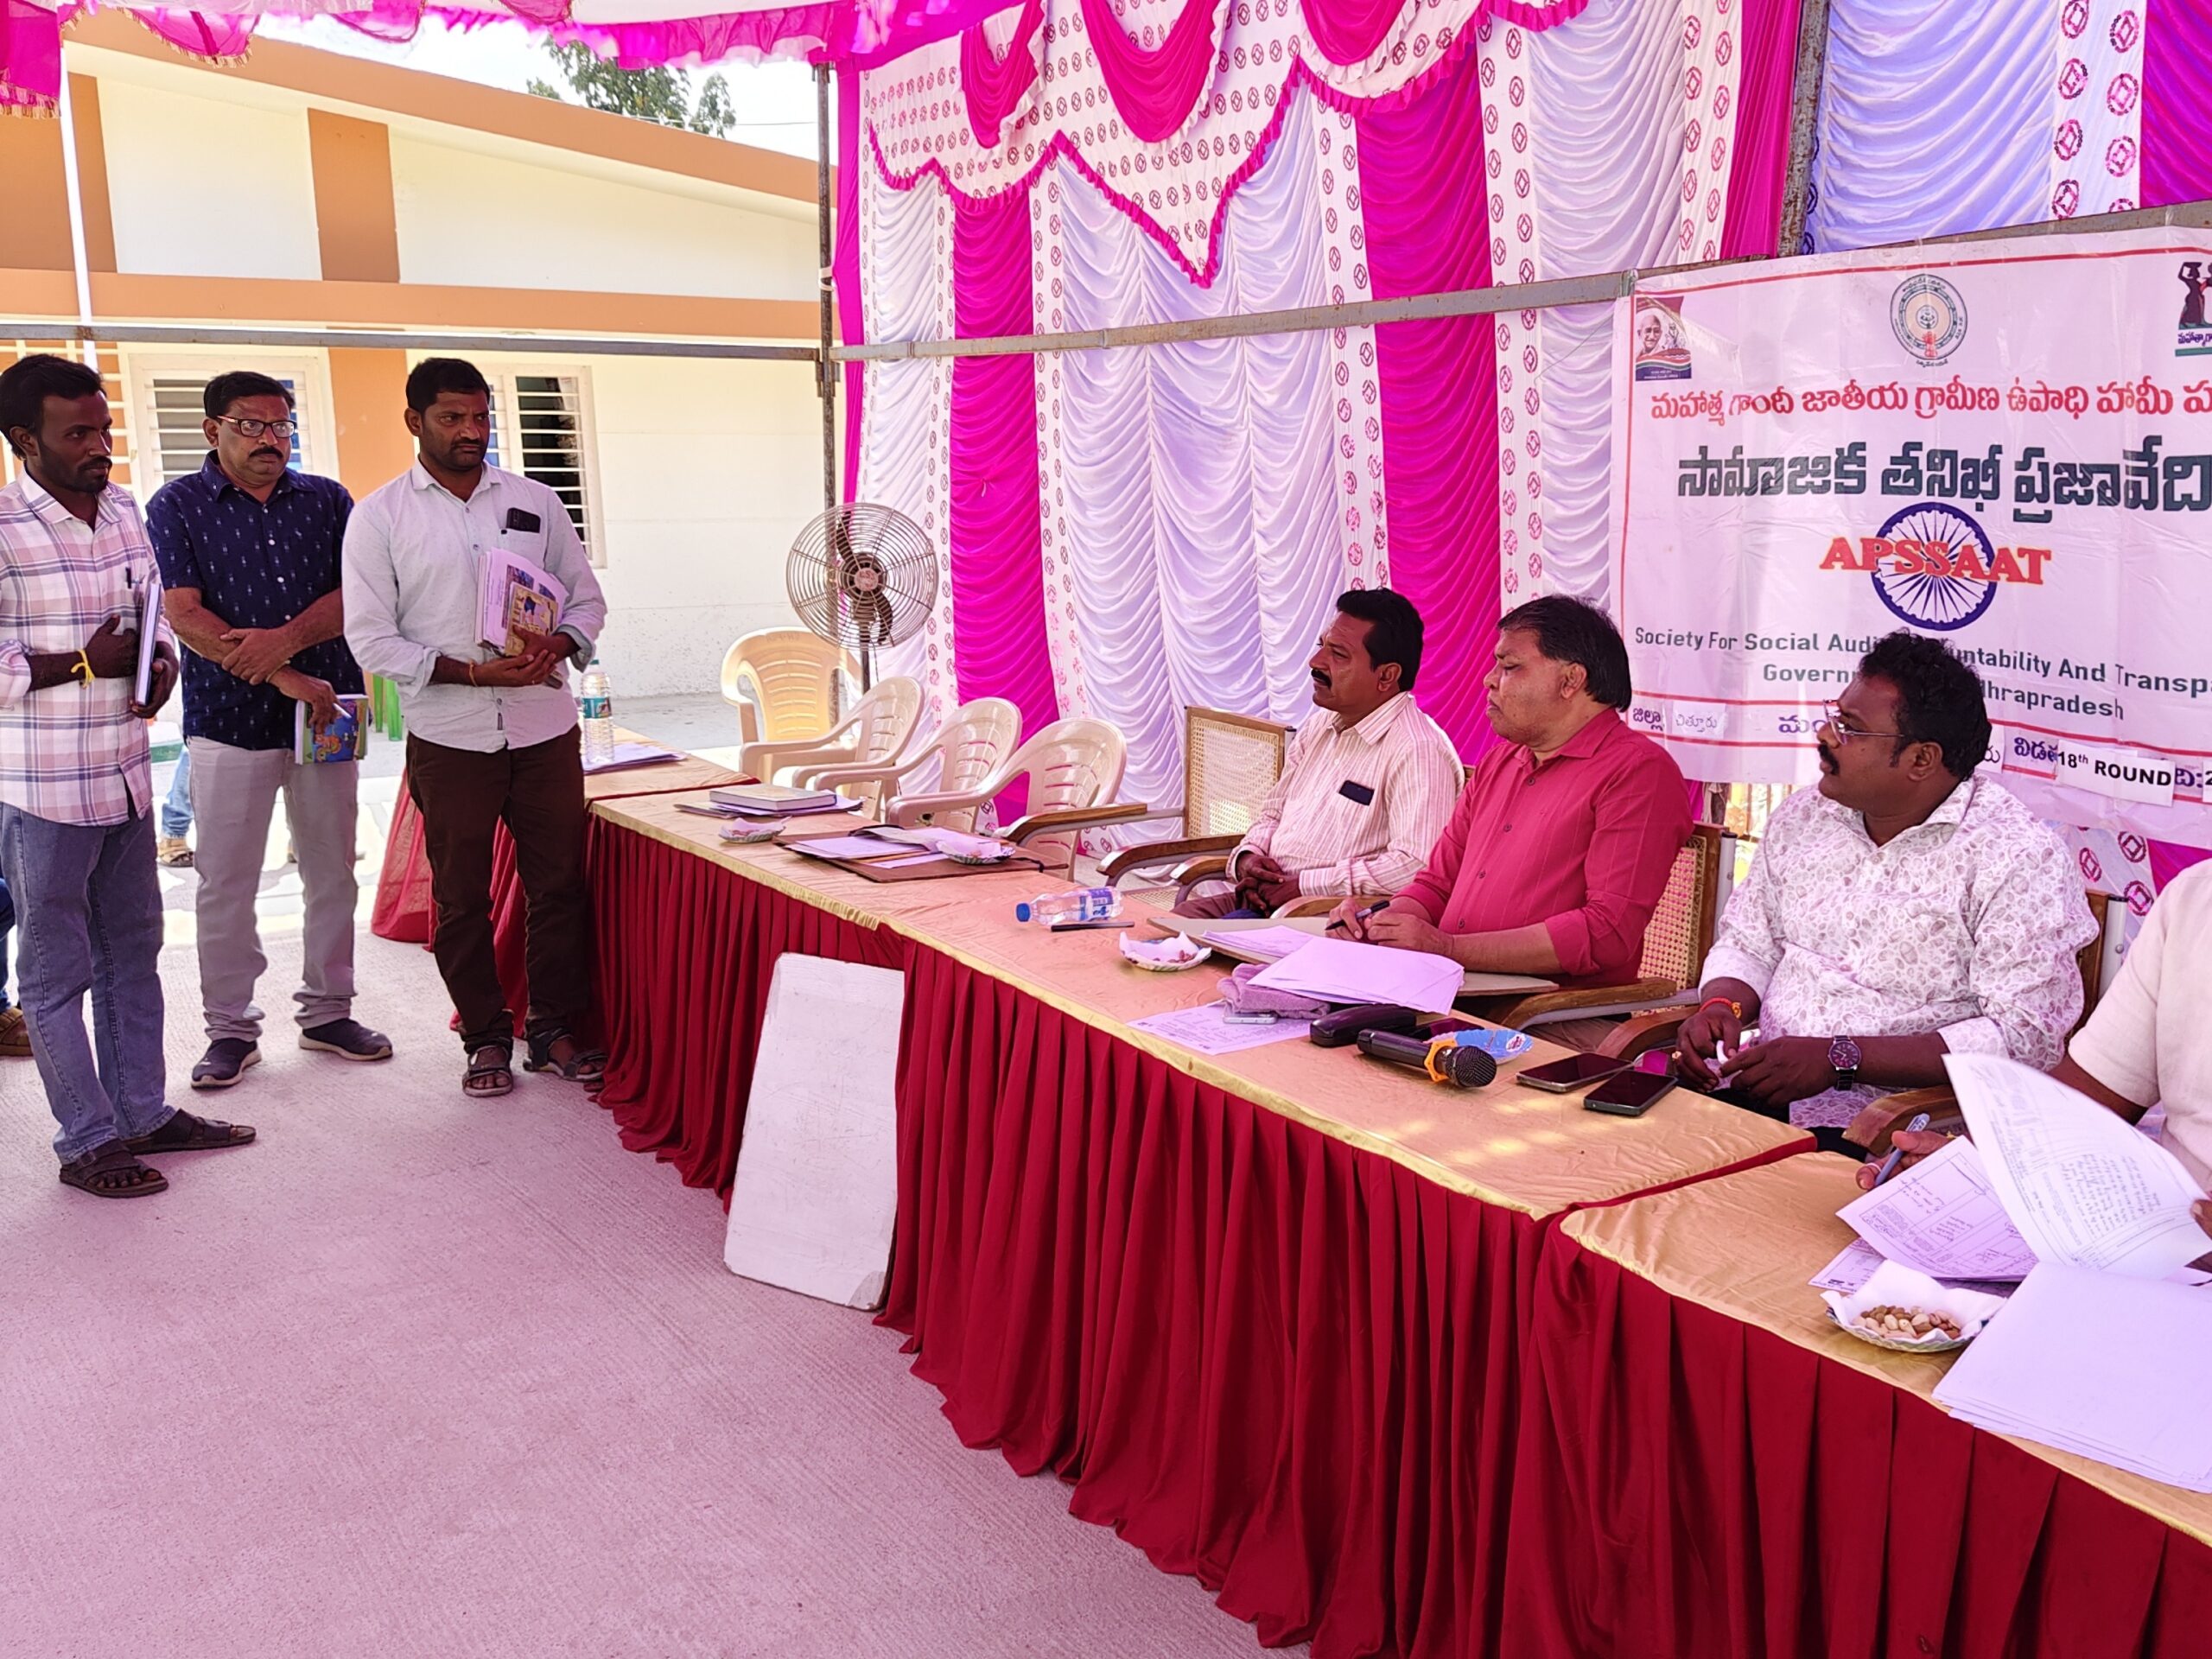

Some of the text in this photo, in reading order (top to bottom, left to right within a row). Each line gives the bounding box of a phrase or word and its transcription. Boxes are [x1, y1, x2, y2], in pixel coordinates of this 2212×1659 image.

[1802, 378, 1908, 413] జాతీయ
[1914, 374, 1999, 419] గ్రామీణ
[2006, 377, 2088, 420] ఉపాధి
[2097, 375, 2173, 415] హామీ
[1678, 442, 1866, 497] సామాజిక
[1881, 442, 2002, 512] తనిఖీ
[1819, 537, 2051, 585] APSSAAT
[1635, 627, 1703, 651] Society
[1708, 632, 1738, 650] For
[1745, 632, 1820, 651] Social
[2058, 658, 2106, 683] And
[2115, 664, 2212, 698] Transp
[1764, 664, 2124, 720] Govern hrapradesh
[2057, 750, 2171, 786] 18th ROUND
